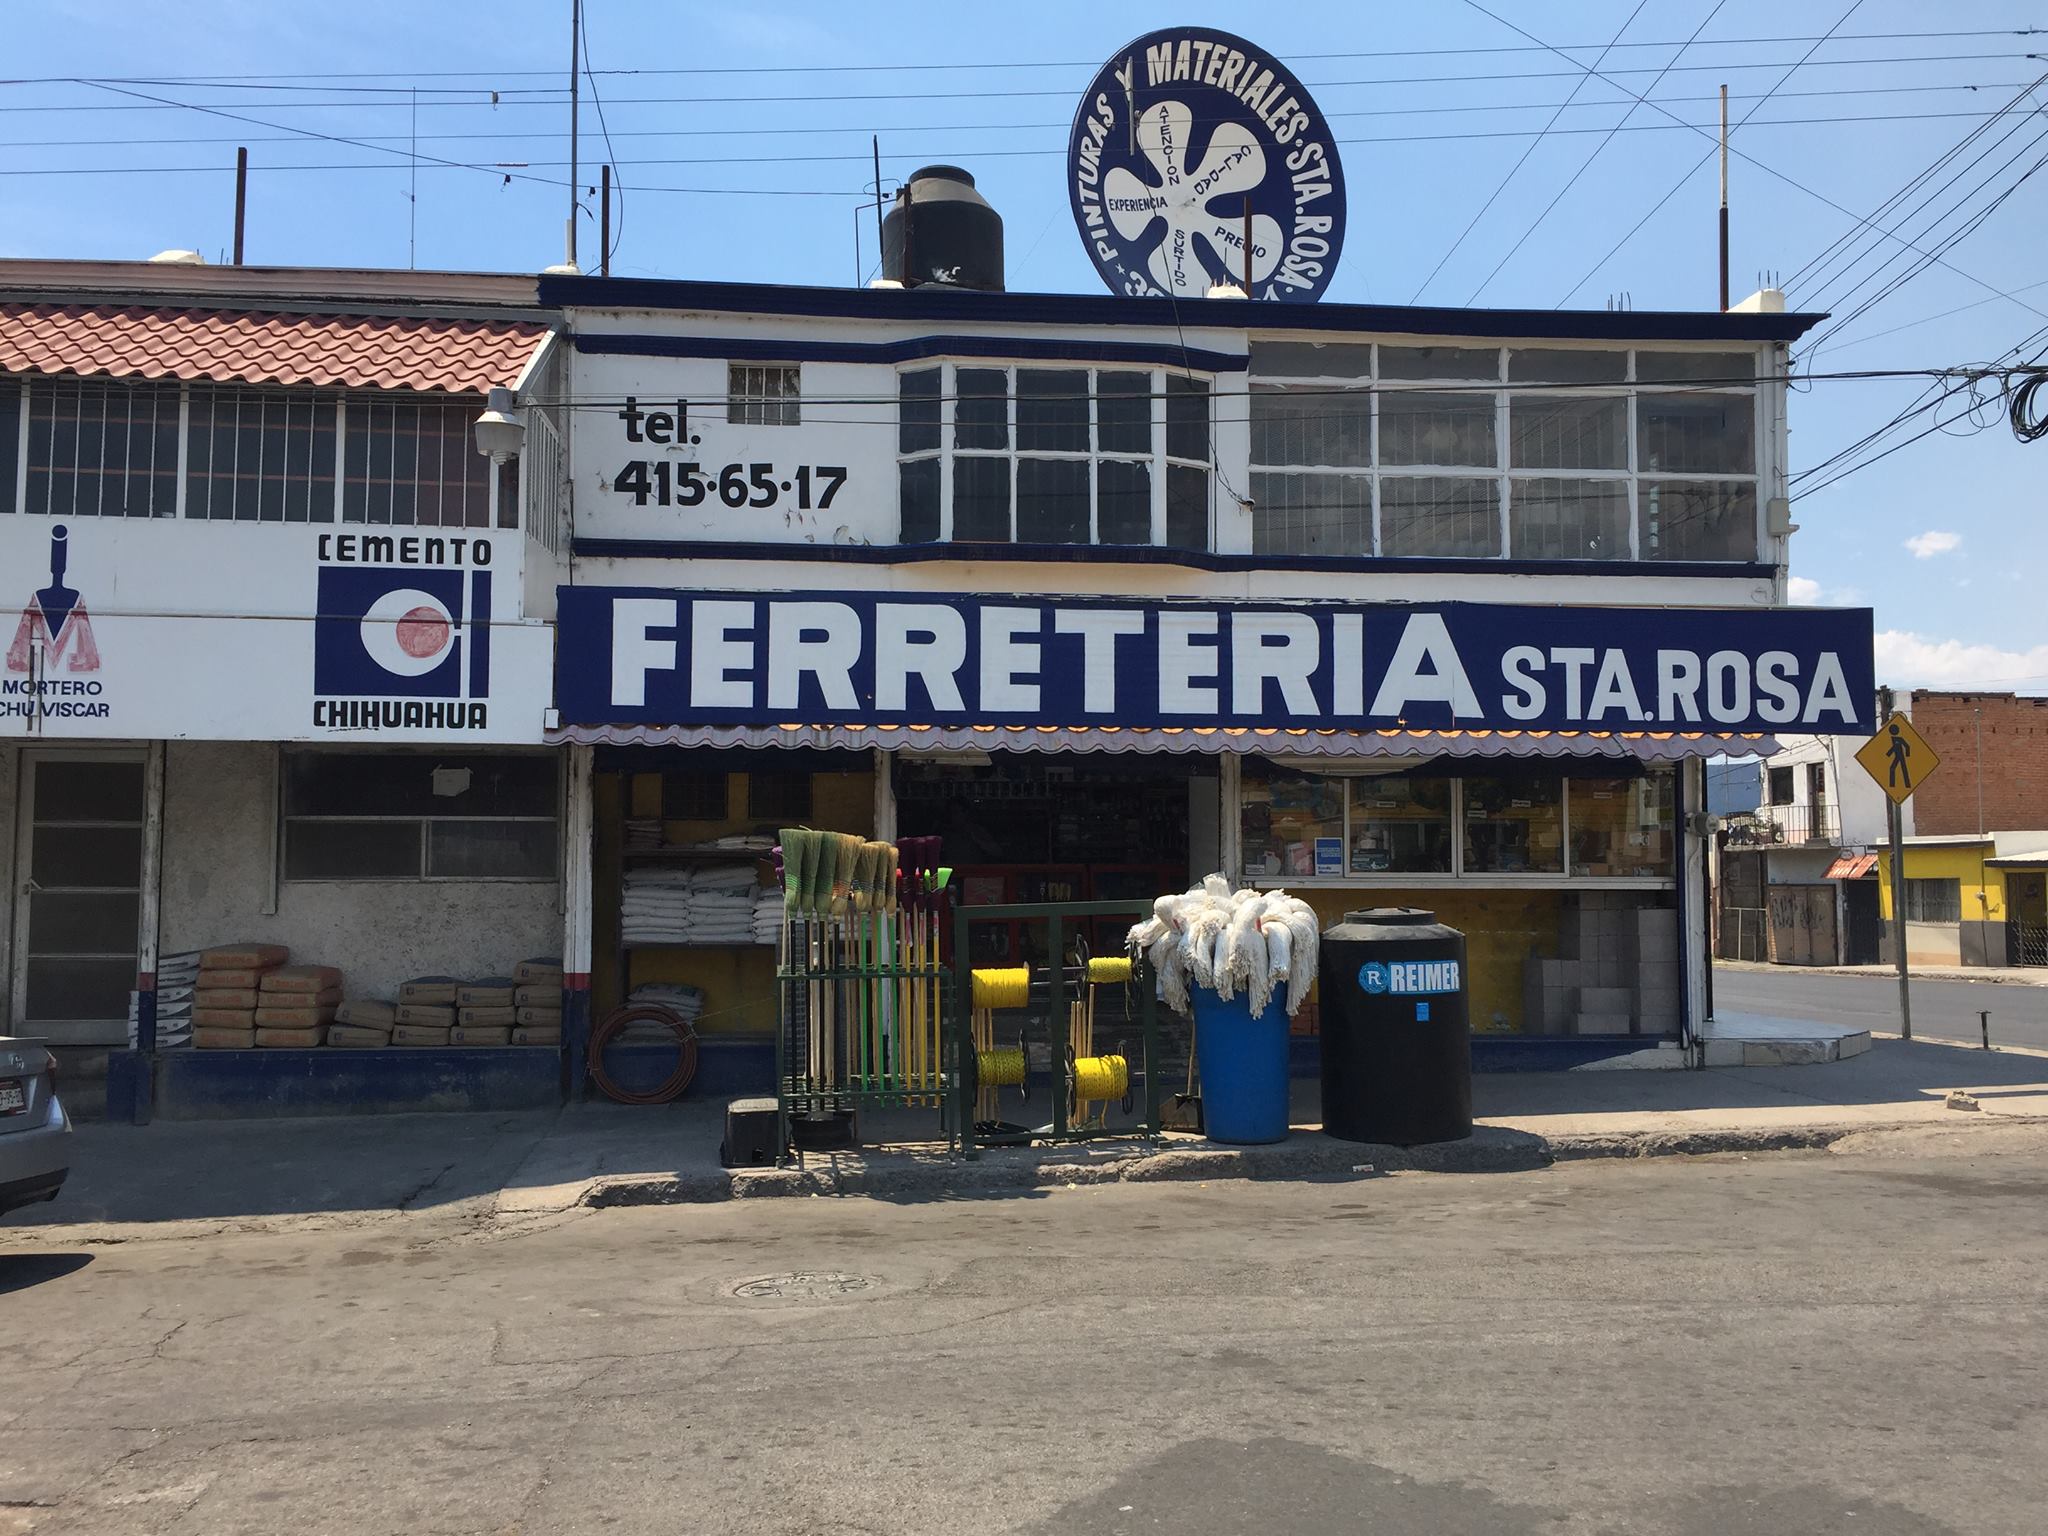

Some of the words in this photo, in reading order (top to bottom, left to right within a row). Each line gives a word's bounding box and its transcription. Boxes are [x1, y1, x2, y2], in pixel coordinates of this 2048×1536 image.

[1078, 93, 1119, 262] PINTURAS
[1114, 56, 1133, 102] Y
[1147, 39, 1309, 144] MATERIALES
[1159, 105, 1180, 187] ATENCION
[1194, 144, 1251, 195] CALIDAD
[1108, 196, 1168, 212] EXPERIENCIA
[1173, 229, 1187, 287] SURTIDO
[619, 397, 701, 445] tel.
[611, 597, 1485, 719] FERRETERIA
[2, 680, 103, 696] MORTERO
[313, 700, 487, 730] CHIHUAHUA
[1390, 962, 1460, 992] REIMER
